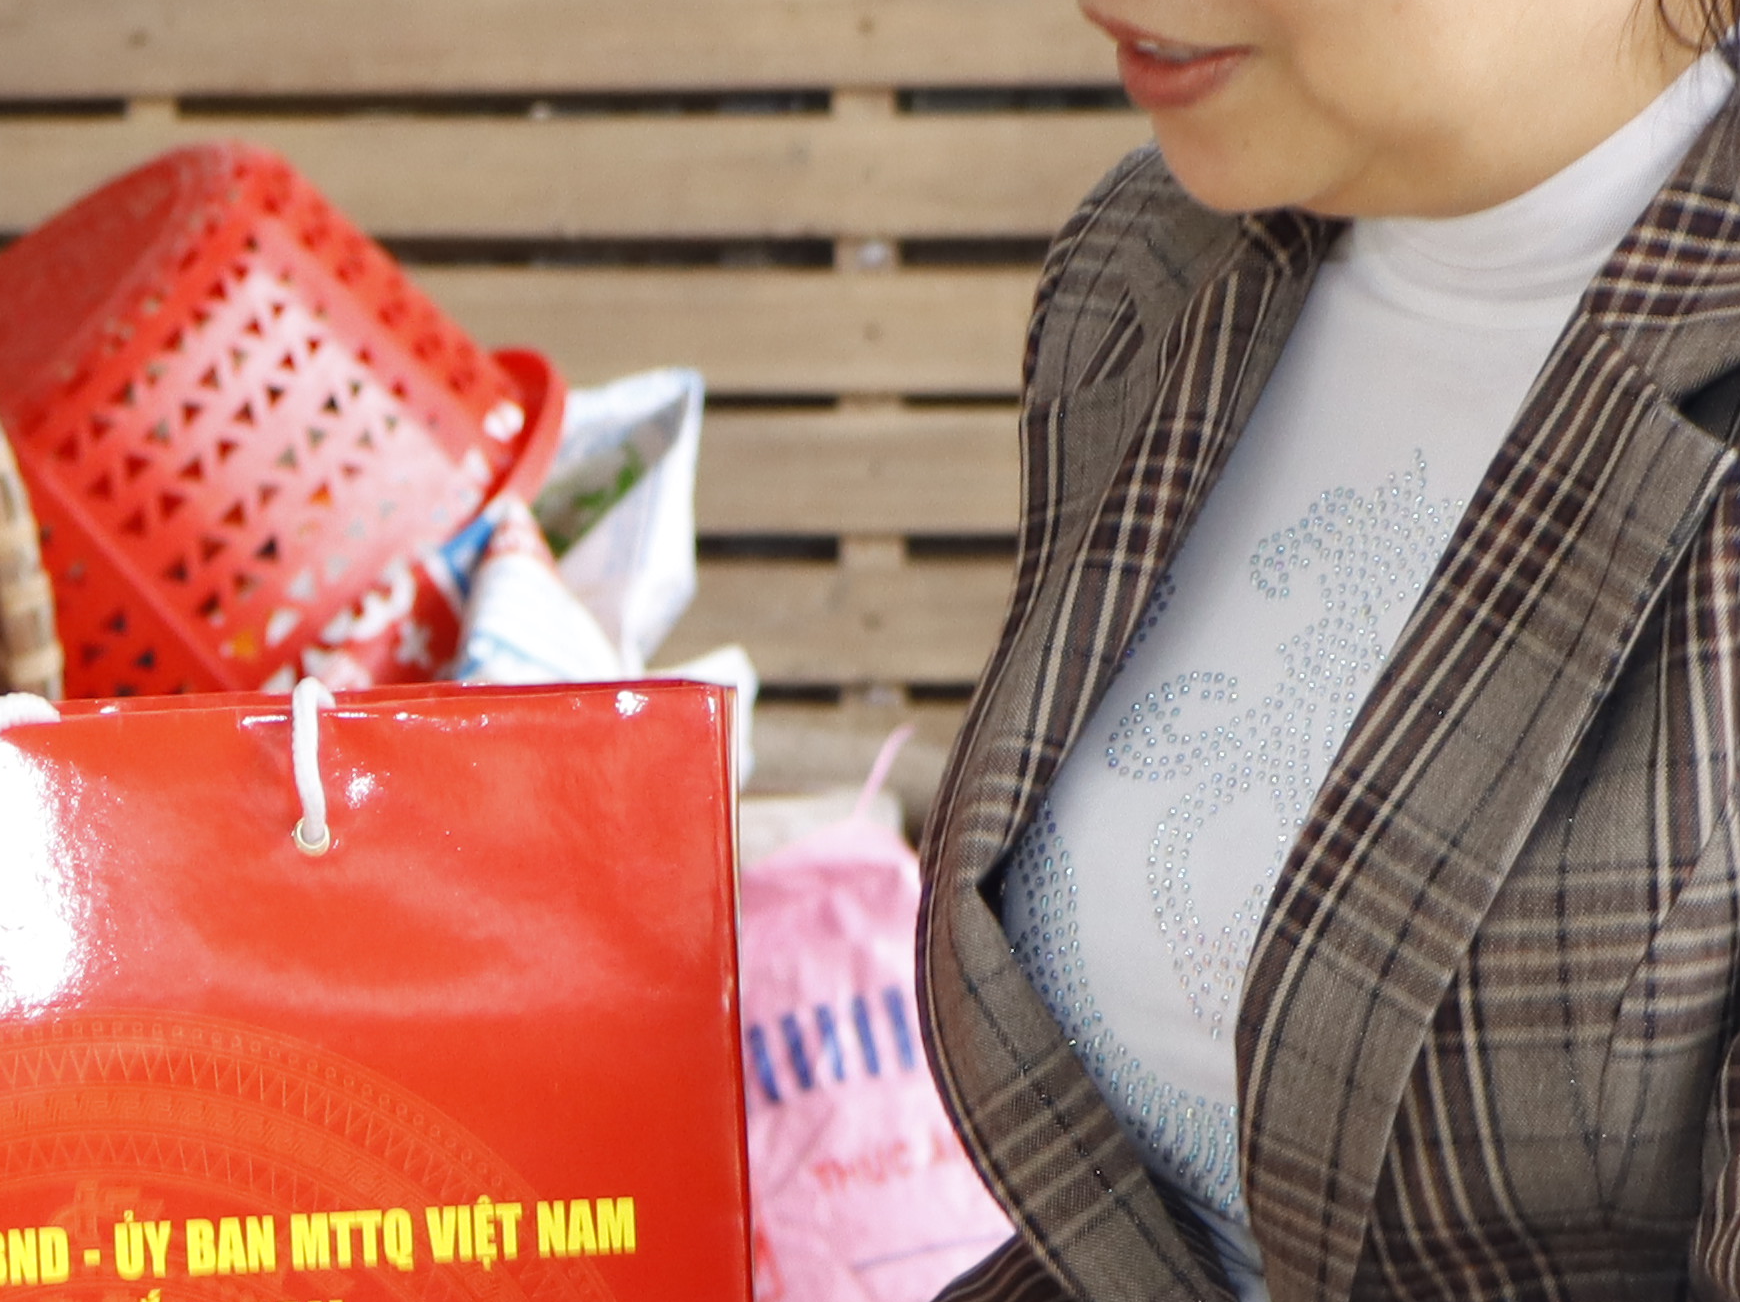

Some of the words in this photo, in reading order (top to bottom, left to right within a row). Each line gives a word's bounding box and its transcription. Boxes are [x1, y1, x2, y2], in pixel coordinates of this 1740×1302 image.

[114, 1210, 171, 1280] ỦY
[185, 1215, 276, 1277] BAN
[290, 1208, 414, 1271] MTTQ
[425, 1195, 523, 1270] VIỆT
[536, 1197, 636, 1258] NAM
